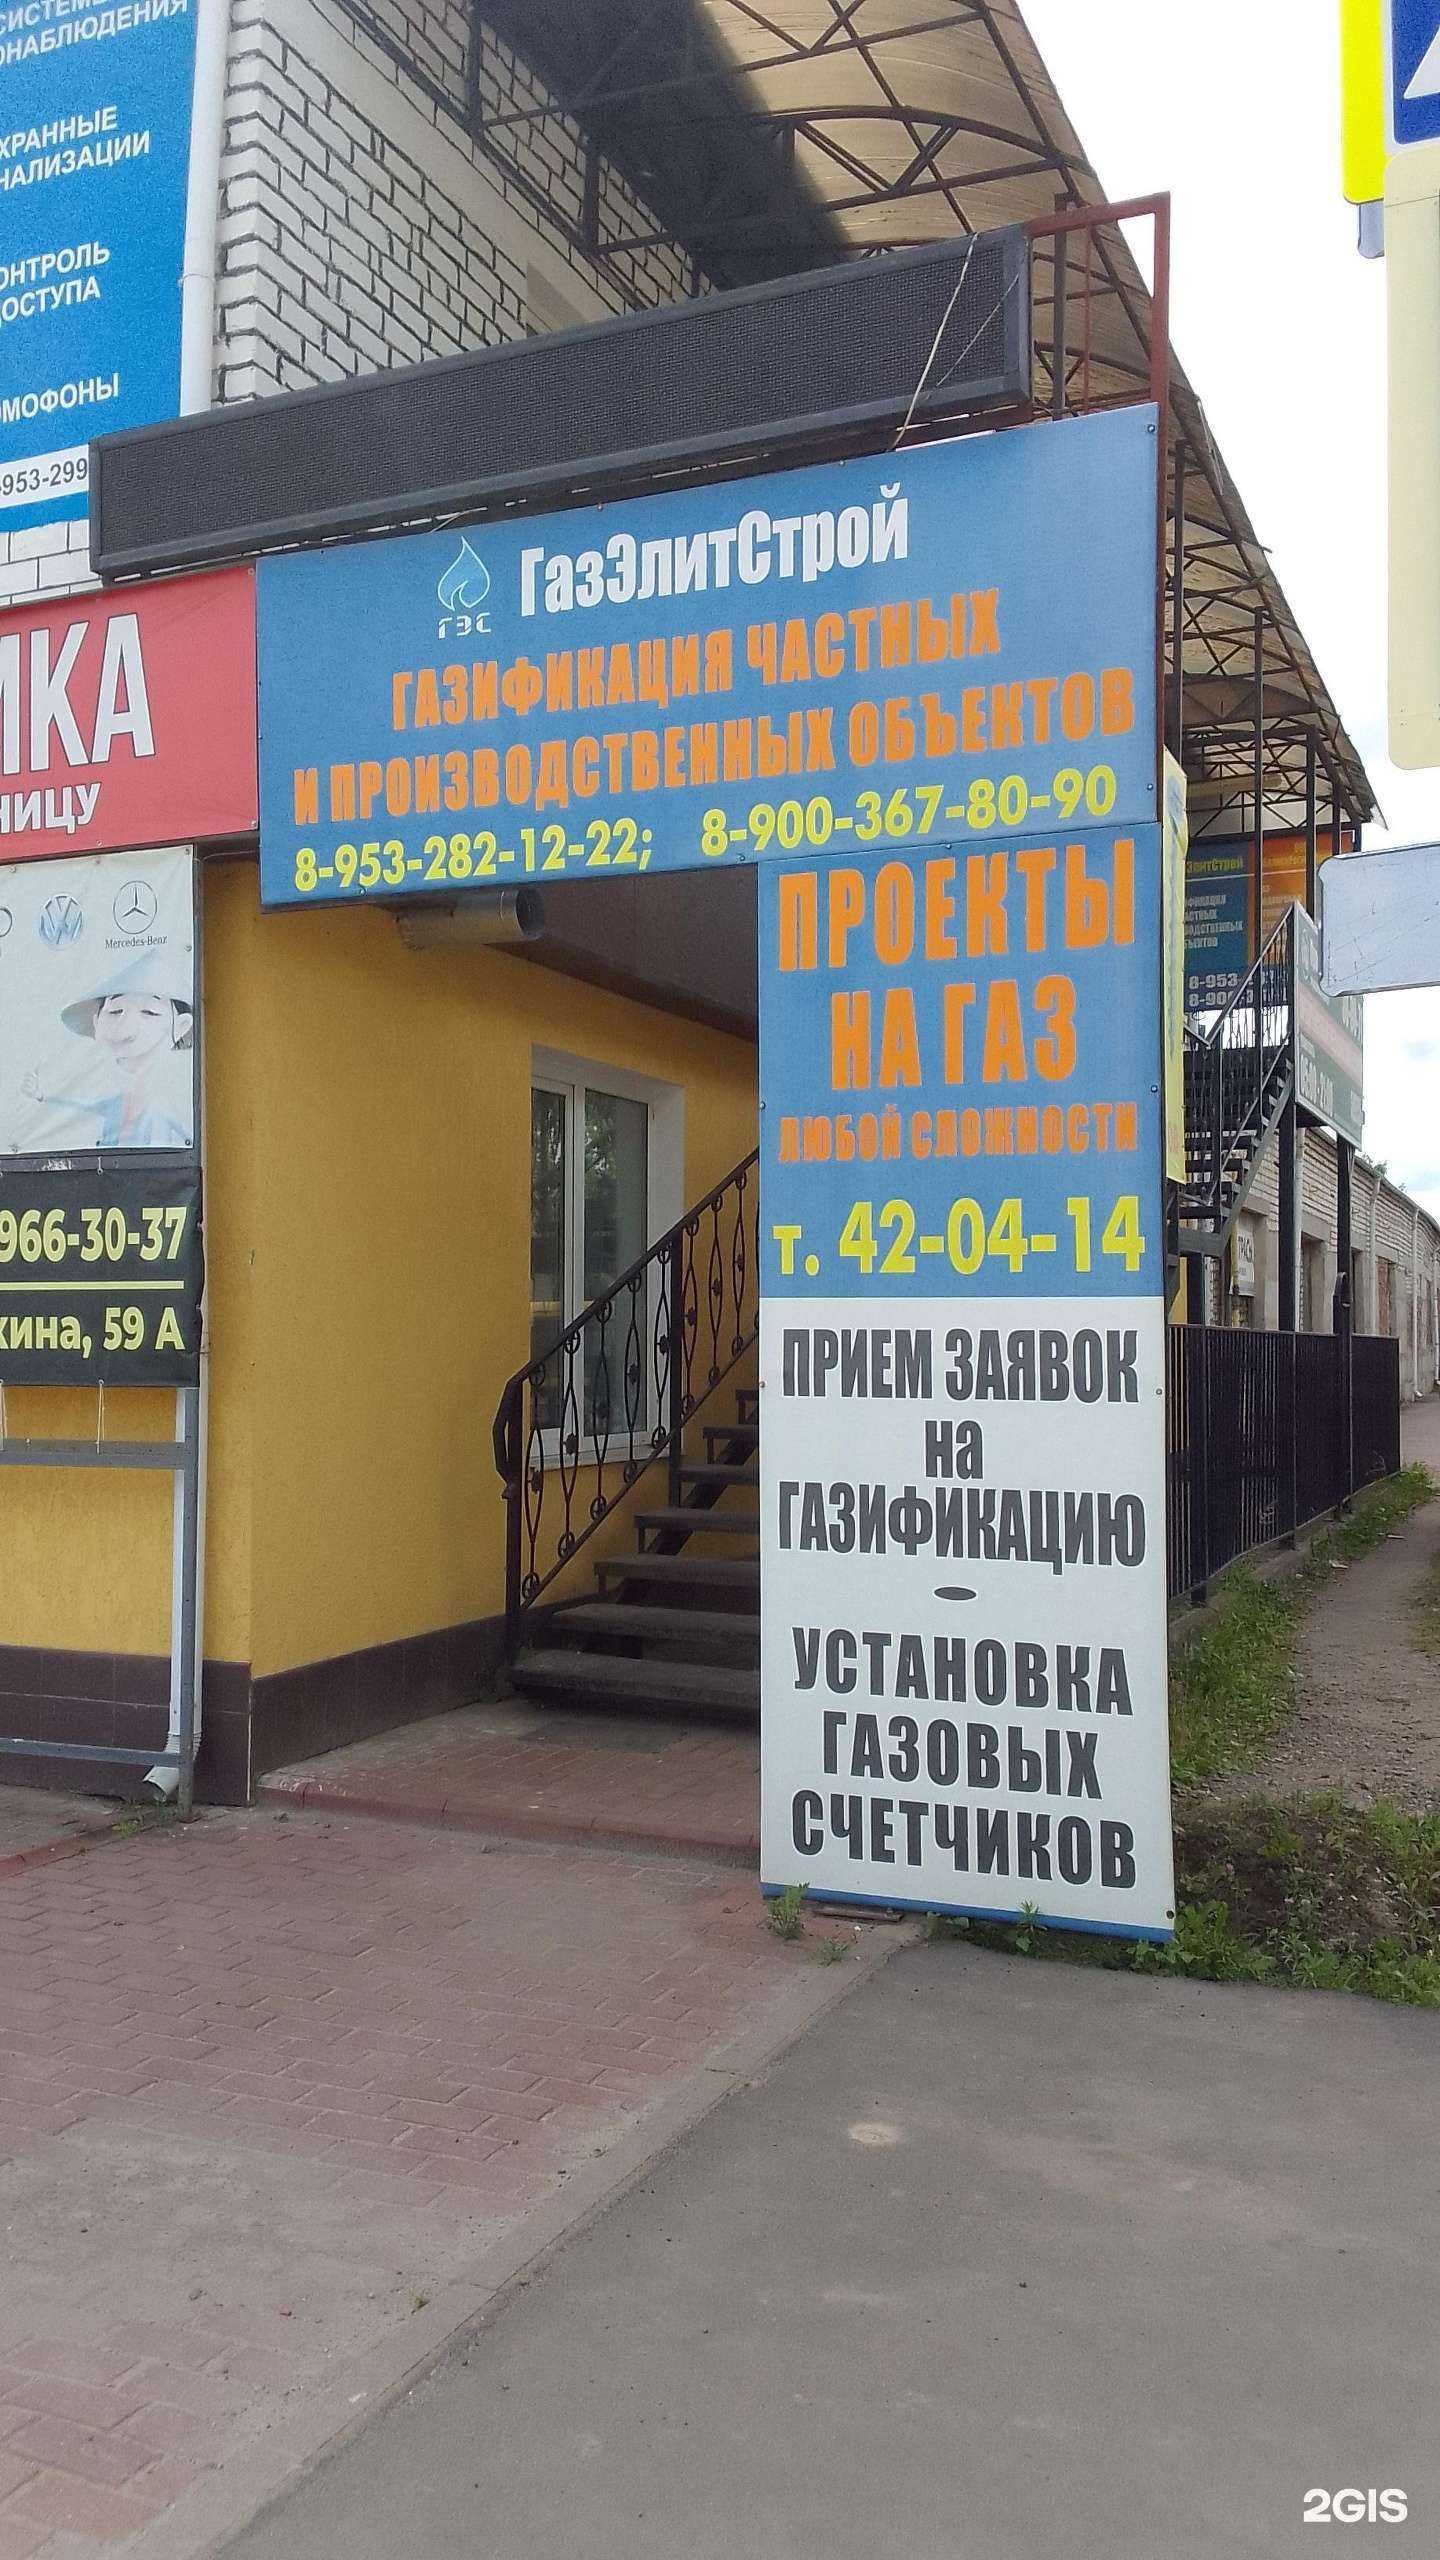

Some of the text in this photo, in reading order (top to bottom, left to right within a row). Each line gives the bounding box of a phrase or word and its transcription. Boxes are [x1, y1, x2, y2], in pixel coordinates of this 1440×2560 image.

[0, 276, 101, 328] ОСТУПА
[0, 373, 119, 424] МОФОНЫ
[0, 458, 88, 496] 953-299
[520, 482, 909, 617] ГазЭлитСтрой
[392, 589, 1000, 730] ГАЗИФИКАЦИЯ ЧАСТНЫХ
[438, 612, 491, 639] ГЭС
[293, 667, 1135, 825] И ПРОИЗВОДСТВЕННЫХ ОБЪЕКТОВ
[295, 764, 1117, 891] 8-953-282-12-22; 8-900-367-80-90
[105, 935, 168, 950] Mercedes-Benz
[778, 839, 1135, 972] ПРОЕКТЫ
[831, 975, 1077, 1091] НА ГАЗ
[779, 1103, 1138, 1164] ЛЮБОЙ СЛОЖНОСТИ
[0, 1206, 187, 1263] 966-30-37
[773, 1196, 1145, 1276] т. 42-04-14
[103, 1306, 144, 1350] 59
[154, 1307, 186, 1350] А
[782, 1328, 1140, 1403] ПРИЕМ ЗАЯВОК
[924, 1420, 983, 1480] на
[778, 1481, 1146, 1576] ГАЗИФИКАЦИЮ
[792, 1626, 1133, 1715] УСТАНОВКА
[823, 1710, 1103, 1800] ГАЗОВЫХ
[791, 1789, 1137, 1888] СЧЕТЧИКОВ
